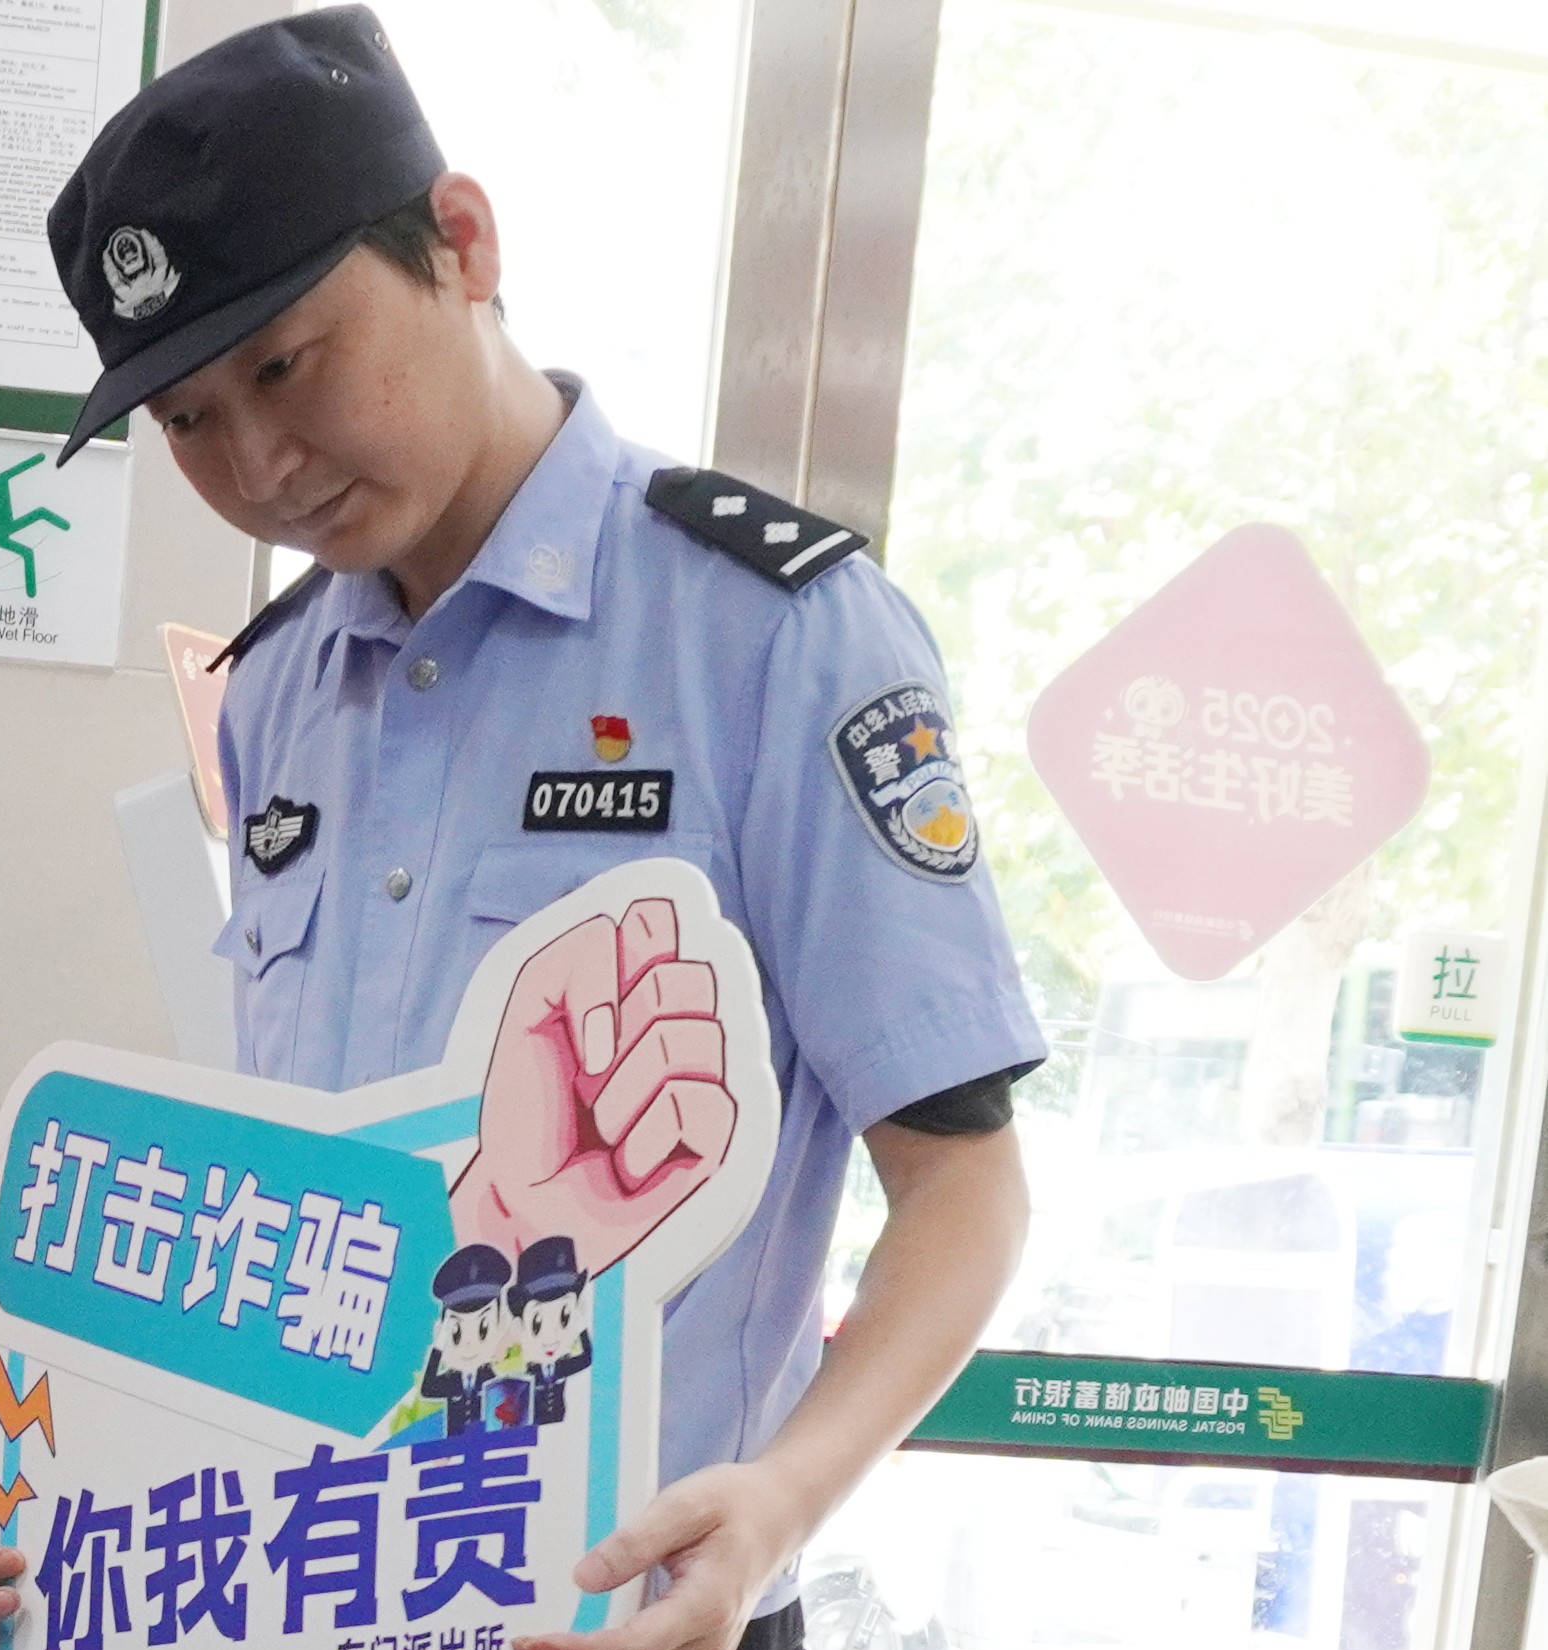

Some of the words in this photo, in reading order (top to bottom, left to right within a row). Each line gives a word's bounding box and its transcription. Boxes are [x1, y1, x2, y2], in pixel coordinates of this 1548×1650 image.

[23, 628, 58, 644] Floor
[533, 779, 661, 820] 070415
[1433, 945, 1481, 999] 拉
[1430, 1005, 1473, 1022] PULL
[13, 1118, 402, 1372] 打击诈骗
